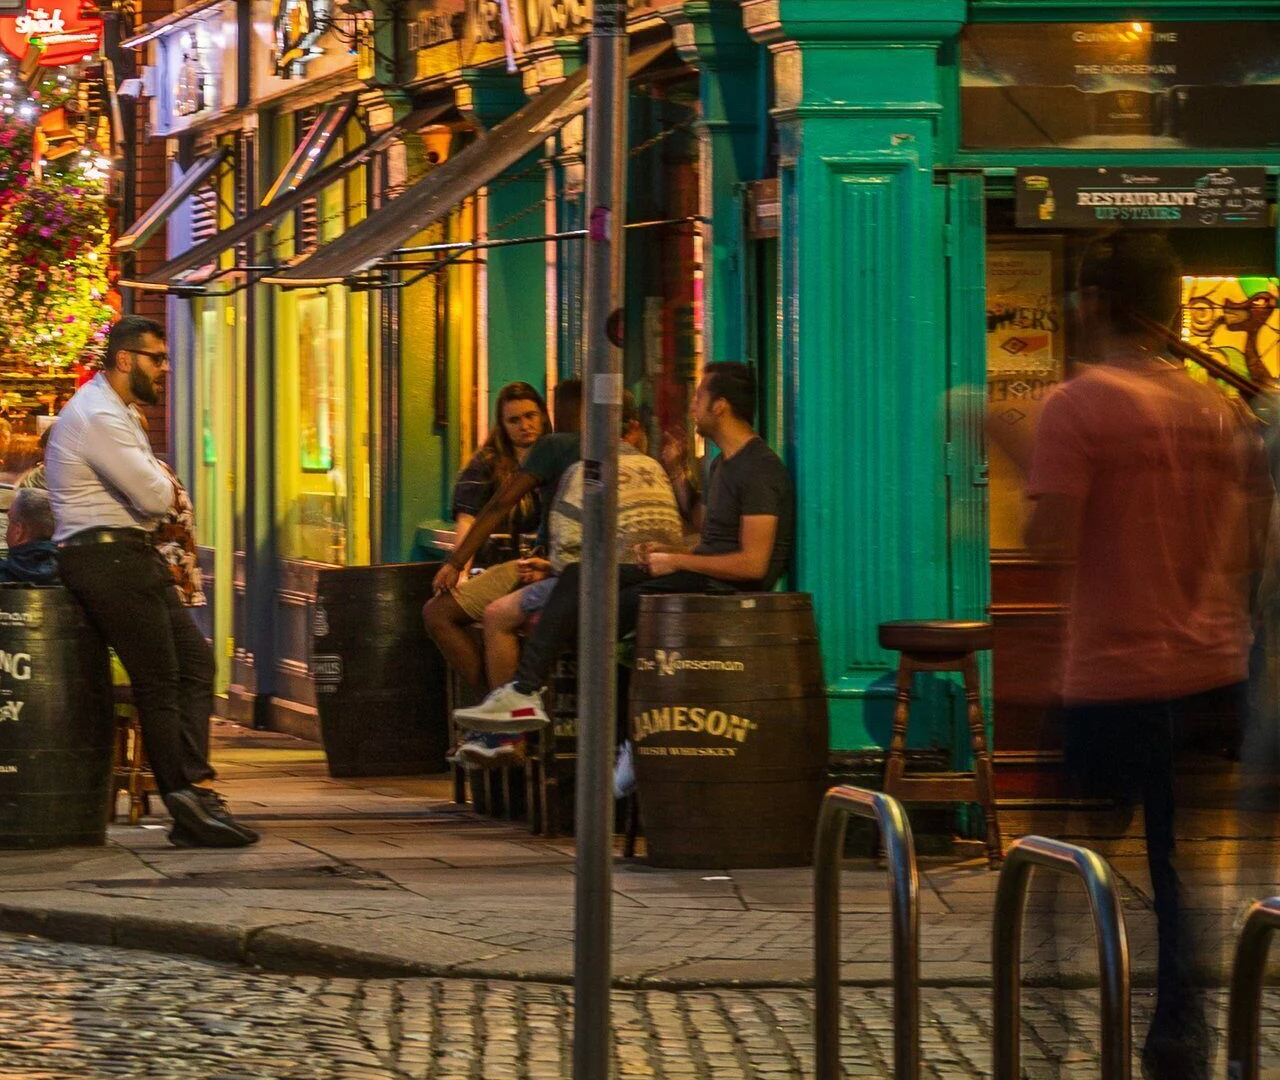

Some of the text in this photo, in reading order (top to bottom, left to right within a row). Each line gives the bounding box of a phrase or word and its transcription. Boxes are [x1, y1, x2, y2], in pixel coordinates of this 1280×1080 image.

[1077, 192, 1198, 206] RESTAURANT
[1095, 206, 1181, 220] UPSTAIRS
[633, 706, 751, 742] JAMESON
